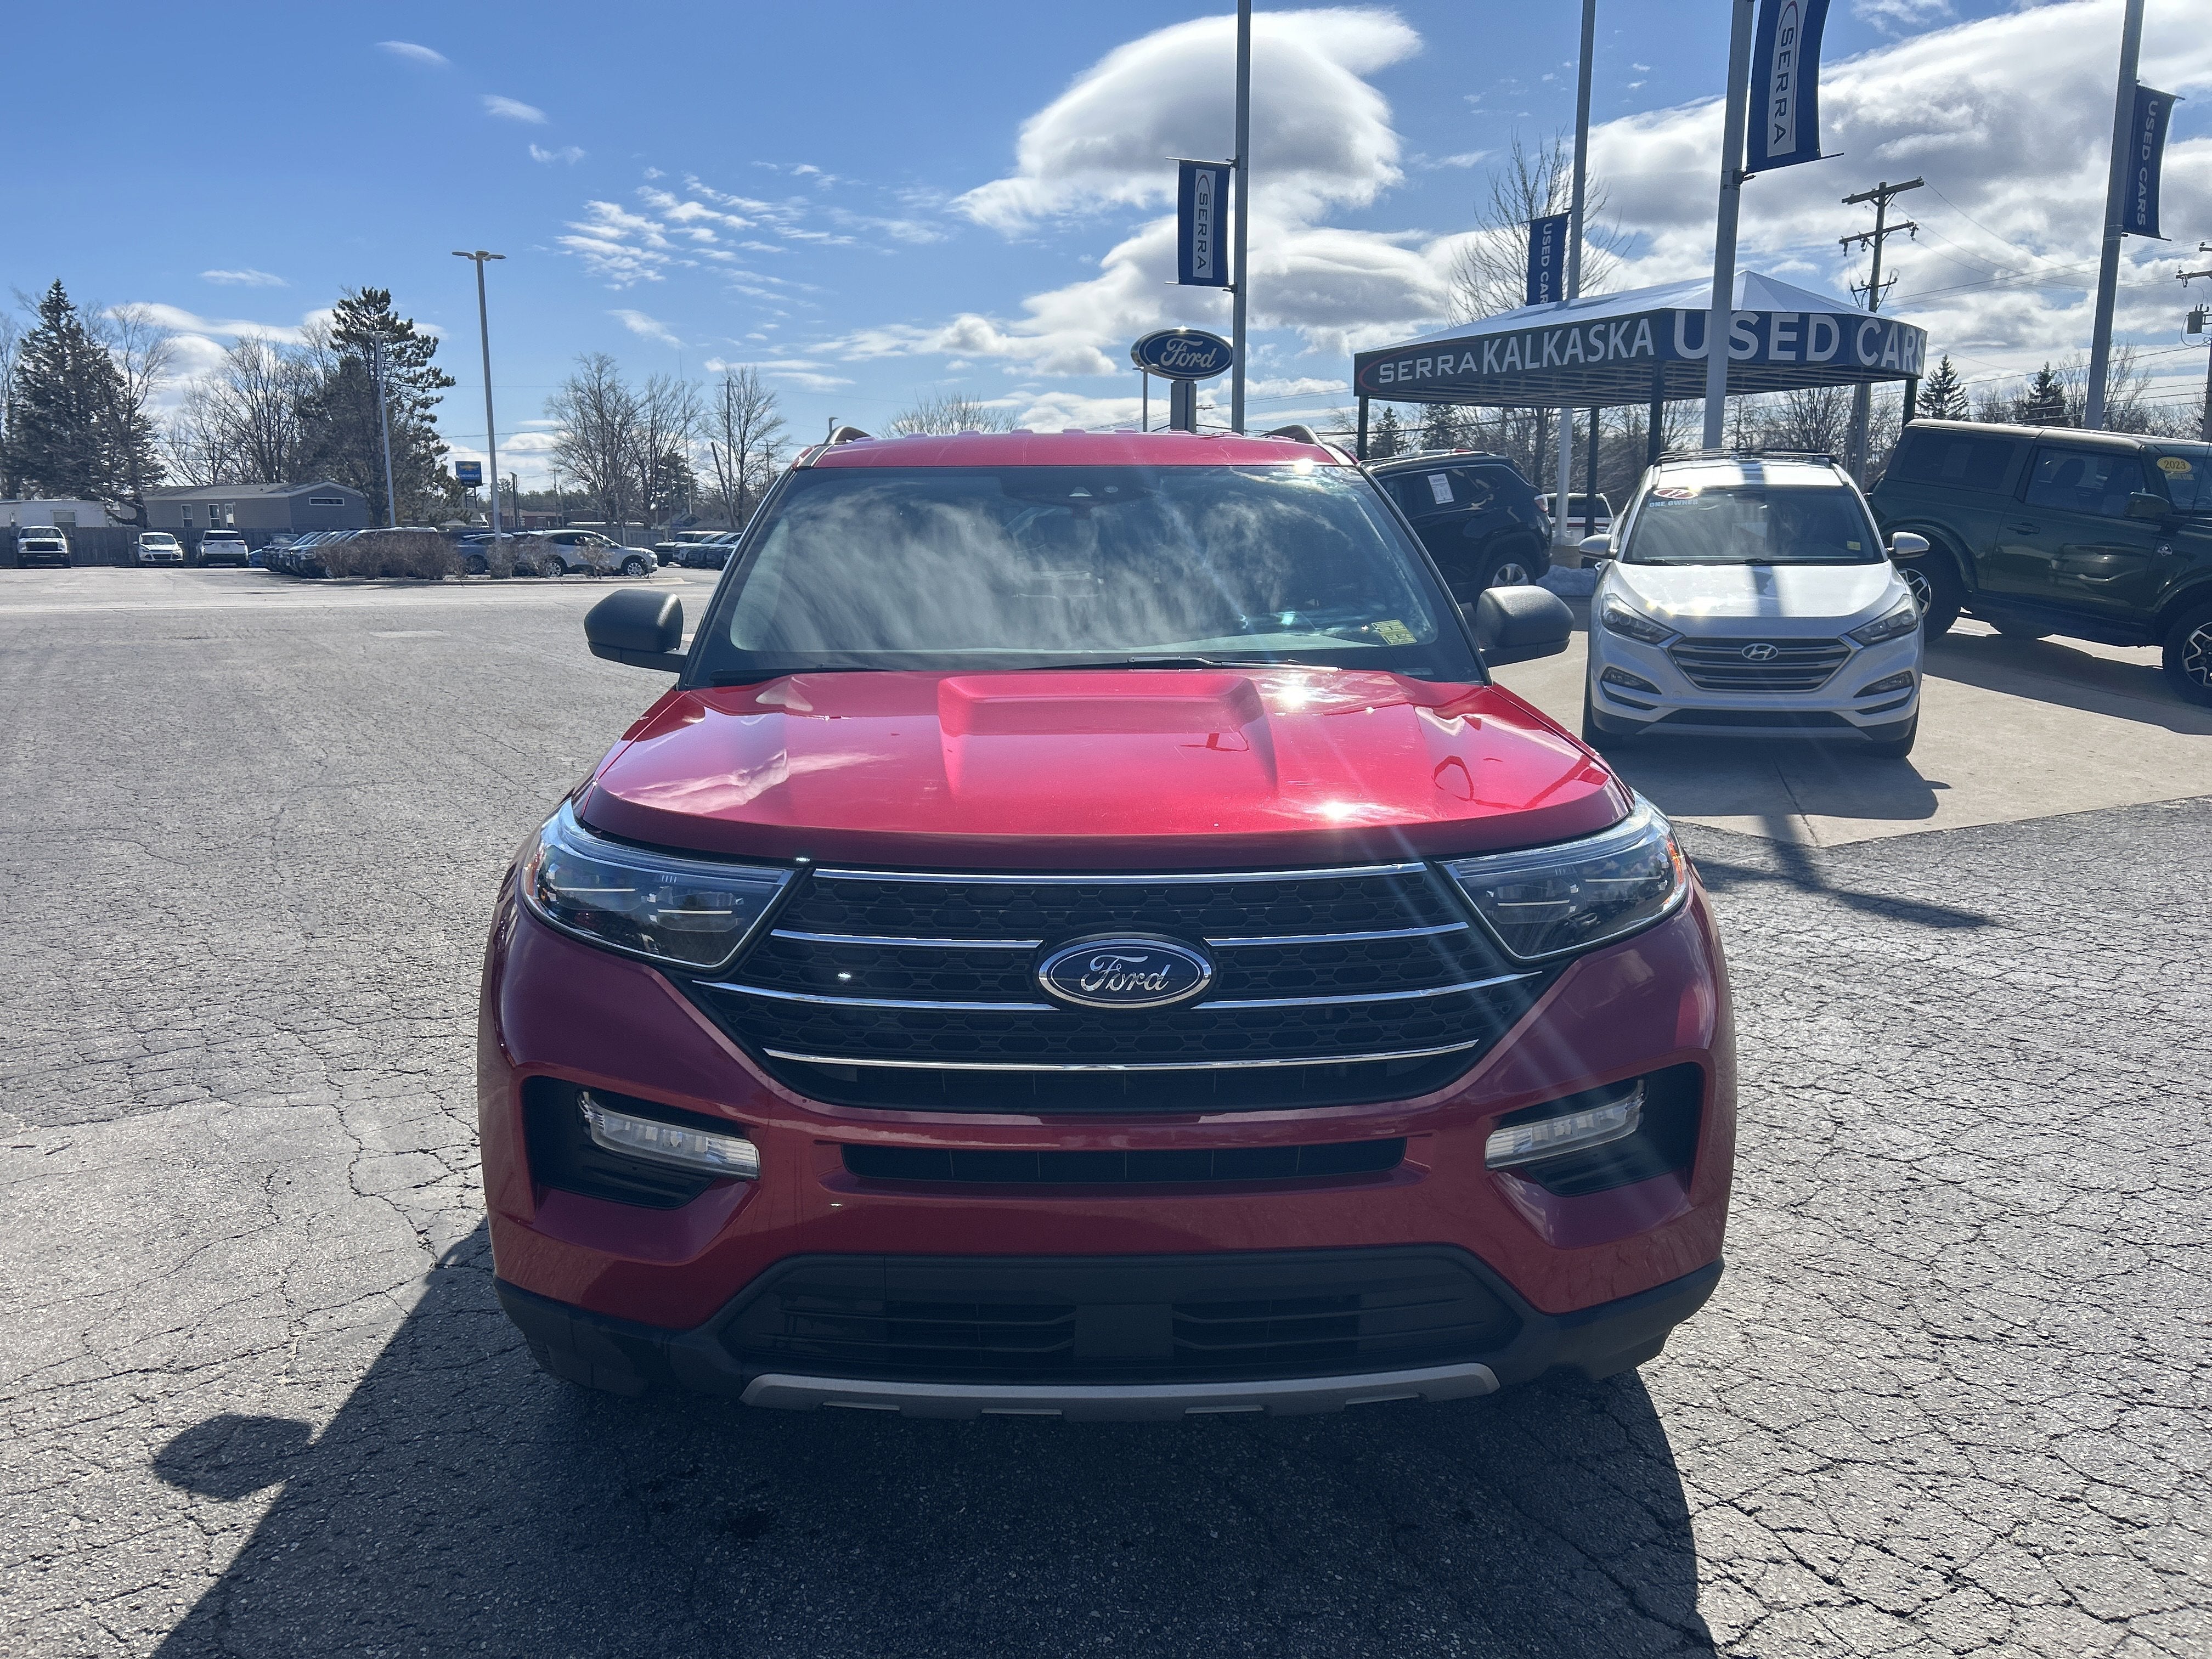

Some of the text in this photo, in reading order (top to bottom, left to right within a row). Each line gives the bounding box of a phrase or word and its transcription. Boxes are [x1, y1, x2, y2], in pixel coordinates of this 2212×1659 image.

[1774, 26, 1794, 145] SERRA
[2137, 100, 2158, 225] USED CARS
[1197, 192, 1208, 270] SERRA
[1541, 222, 1553, 267] USED
[1160, 338, 1217, 368] Ford
[1378, 310, 1925, 383] SERRA KALKASKA USED CARS
[2164, 460, 2186, 470] 2023
[1080, 954, 1171, 991] Ford
